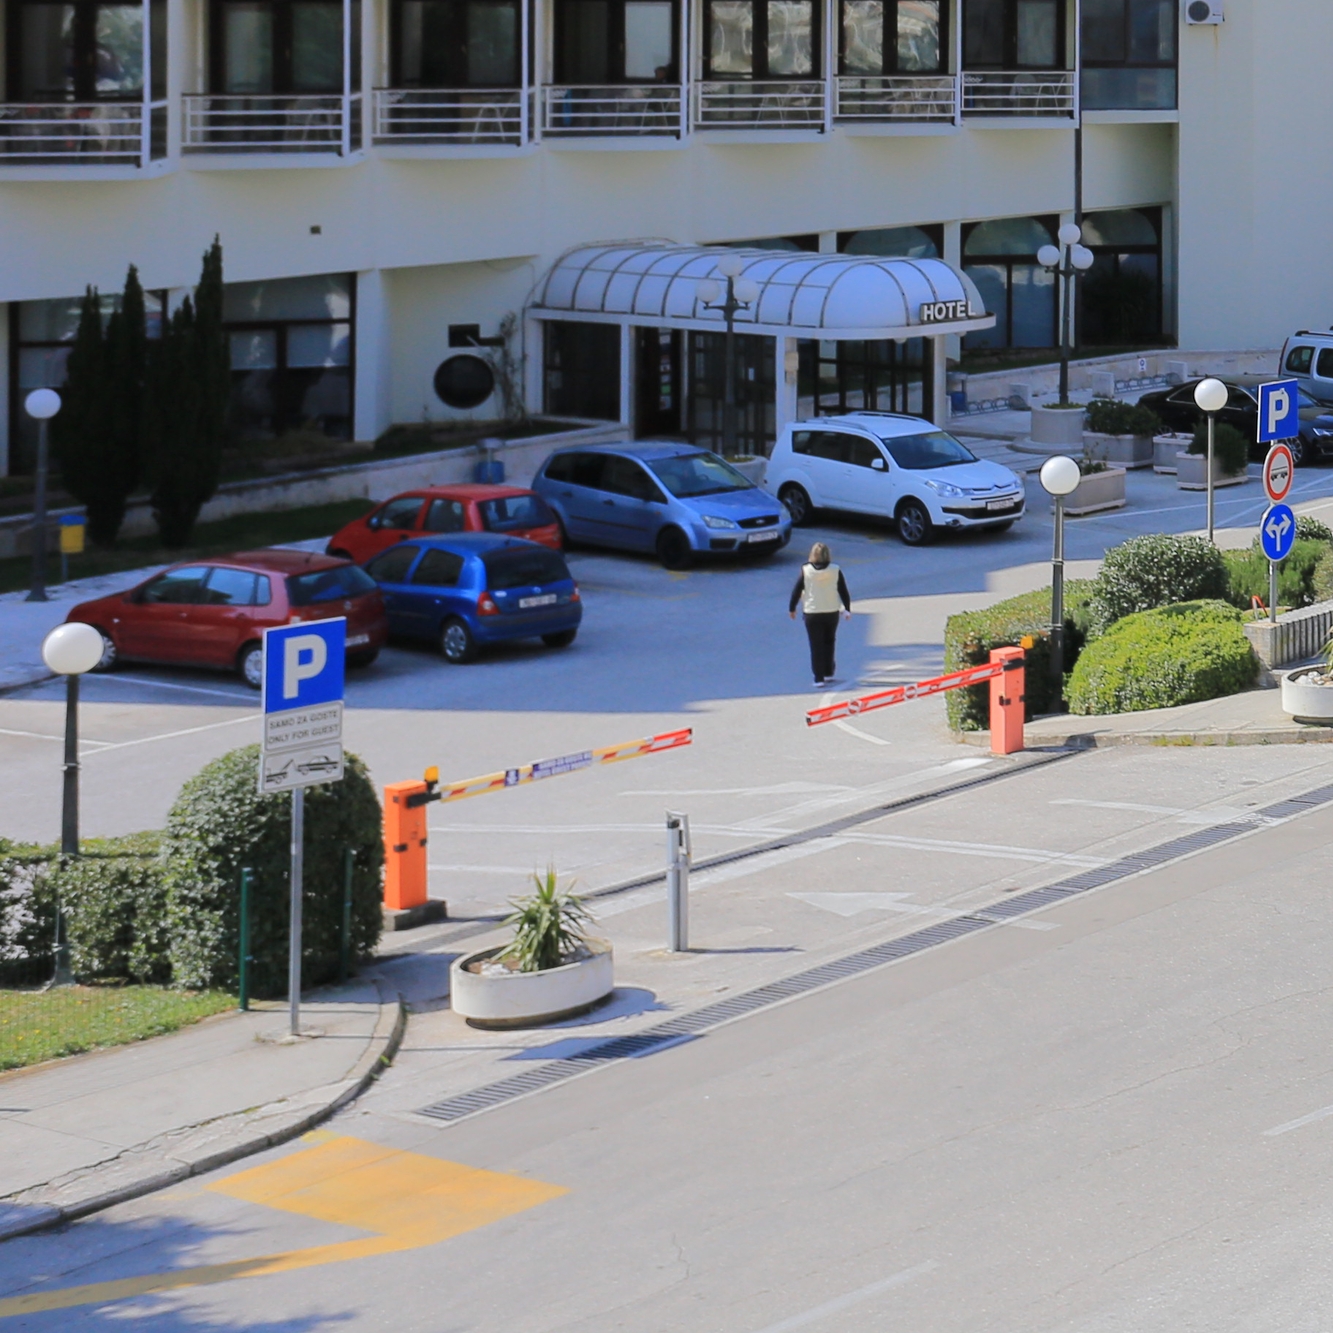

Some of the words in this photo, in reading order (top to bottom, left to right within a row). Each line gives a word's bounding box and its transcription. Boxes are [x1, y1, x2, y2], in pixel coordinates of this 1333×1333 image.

[923, 300, 977, 321] HOTEL
[1268, 389, 1289, 433] P
[283, 633, 328, 700] P
[269, 716, 295, 730] SAMO
[297, 714, 308, 726] ZA
[310, 709, 338, 723] GOSTE
[267, 732, 291, 745] ONLY
[292, 728, 310, 740] FOR
[311, 723, 340, 736] GUEST
